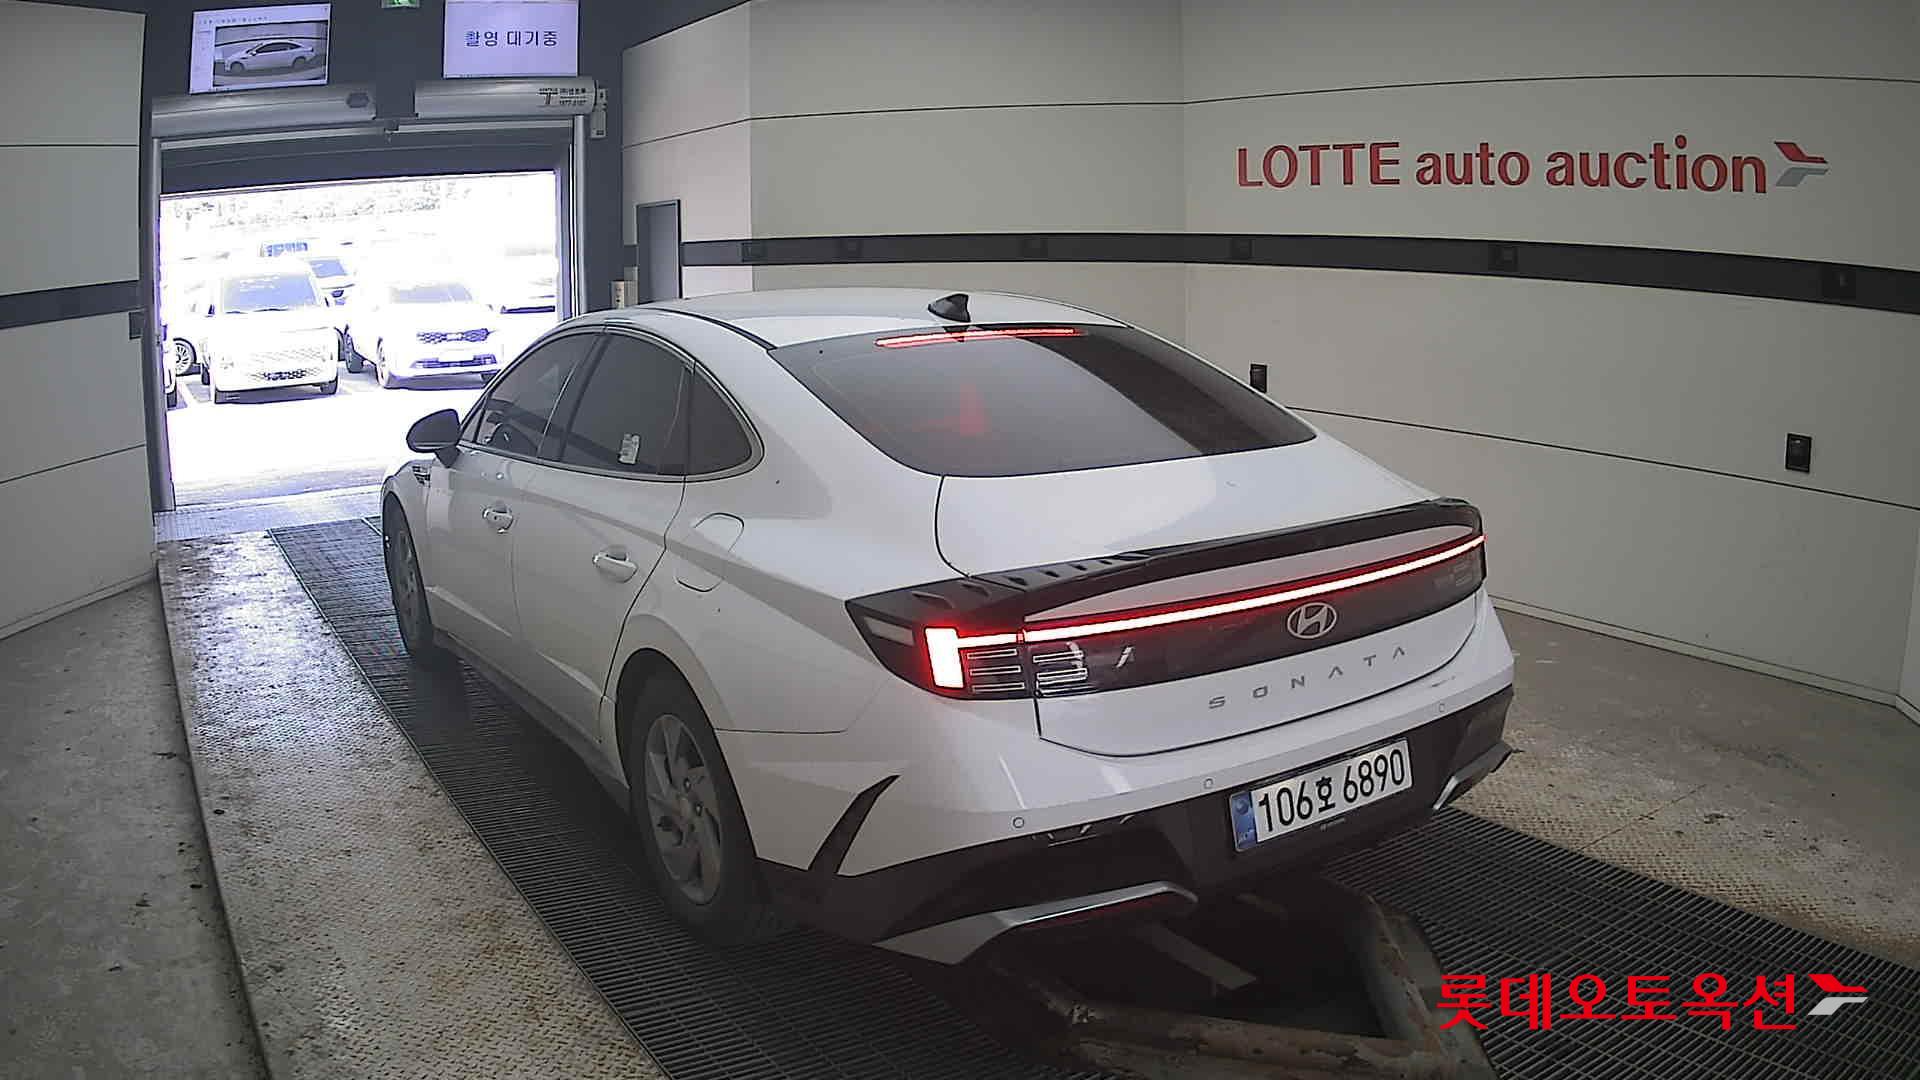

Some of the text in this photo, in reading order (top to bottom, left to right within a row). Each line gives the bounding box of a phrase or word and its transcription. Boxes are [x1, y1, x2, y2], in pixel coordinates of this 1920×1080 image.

[465, 30, 557, 47] 촬영 대기중
[1238, 134, 1768, 194] LOTTE auto auction
[1208, 646, 1406, 710] SONATA
[1258, 749, 1405, 832] 106호 6890
